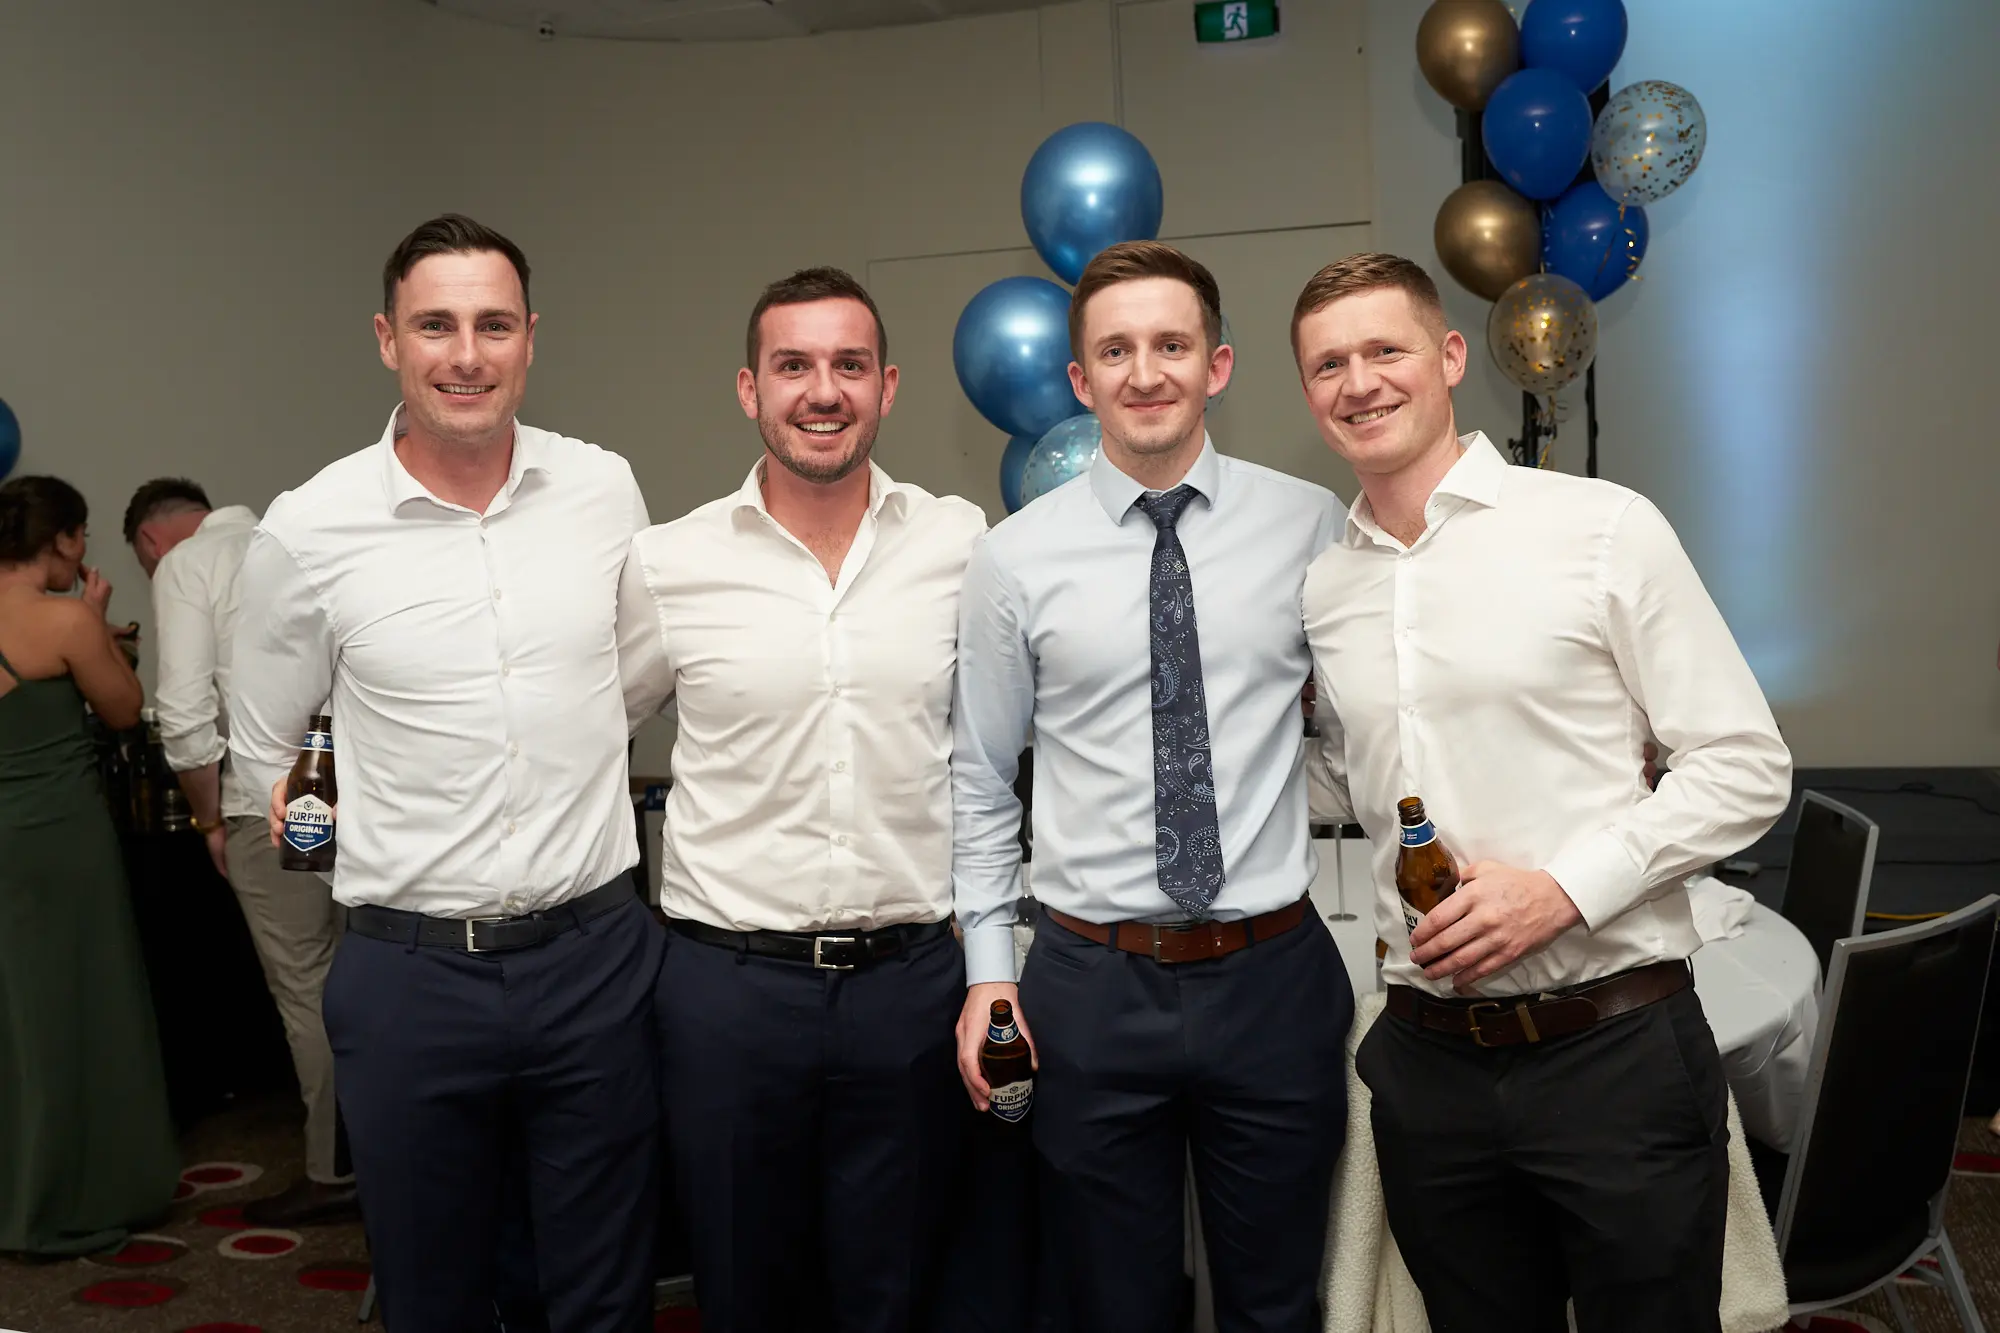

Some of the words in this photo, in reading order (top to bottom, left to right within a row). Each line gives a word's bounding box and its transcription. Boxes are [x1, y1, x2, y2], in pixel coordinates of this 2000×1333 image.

[289, 810, 328, 823] FURPHY
[289, 824, 324, 835] ORIGINAL
[994, 1086, 1030, 1103] FURPHY
[997, 1098, 1029, 1111] ORIGINAL
